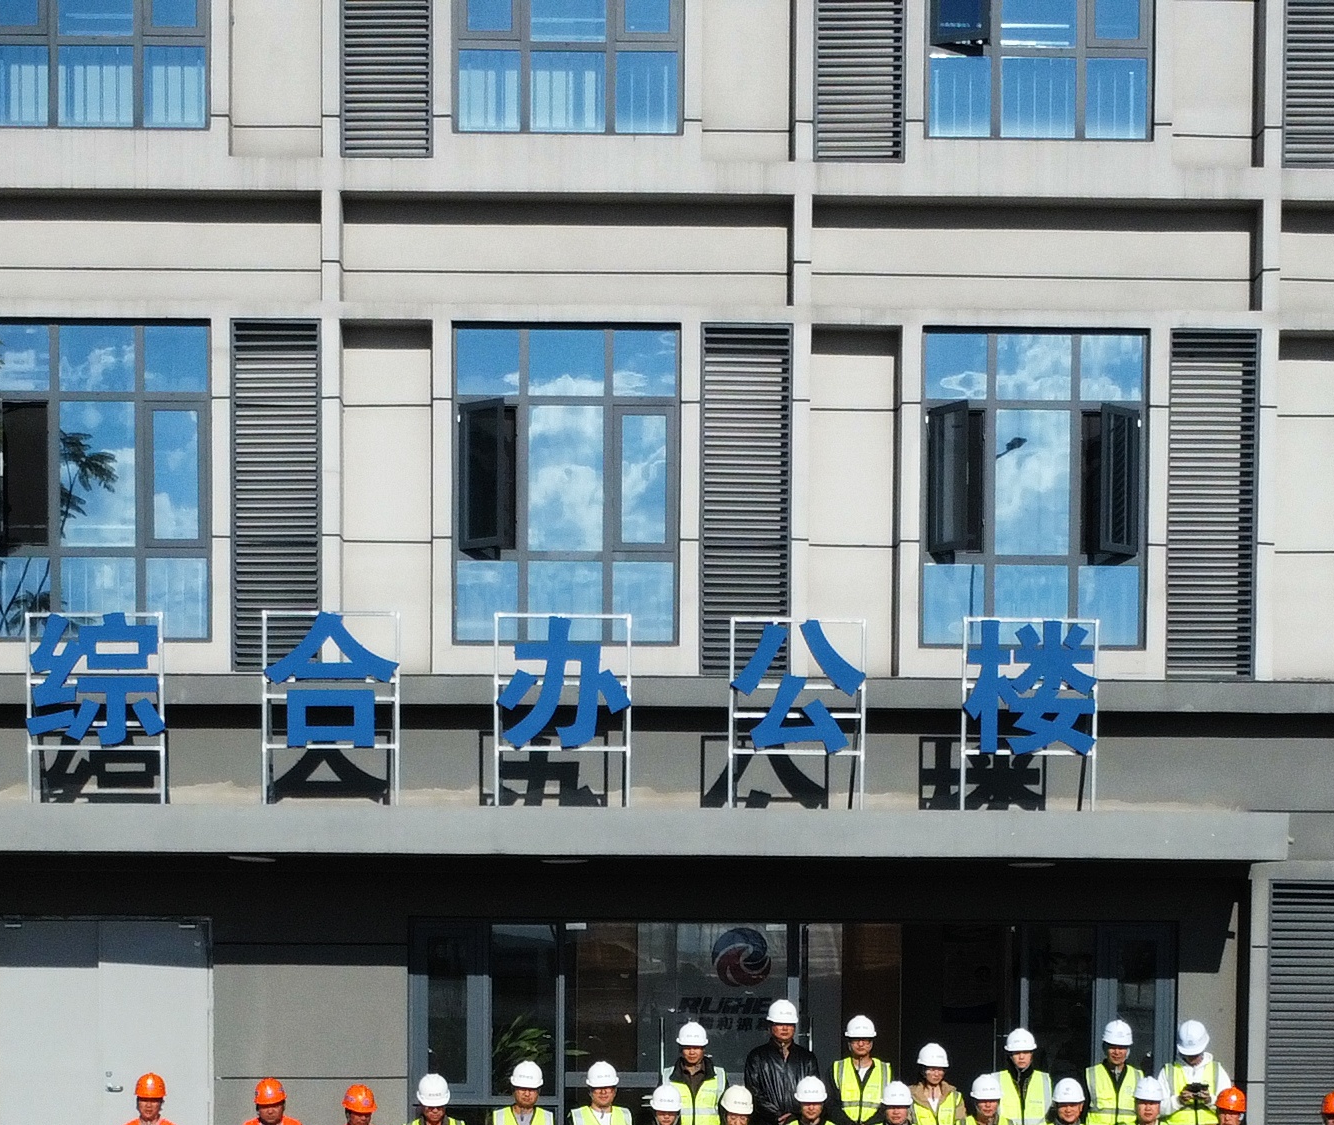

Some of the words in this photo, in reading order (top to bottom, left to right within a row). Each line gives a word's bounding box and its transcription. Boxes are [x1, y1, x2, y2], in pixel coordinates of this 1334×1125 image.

[26, 611, 1098, 755] 综合办公楼
